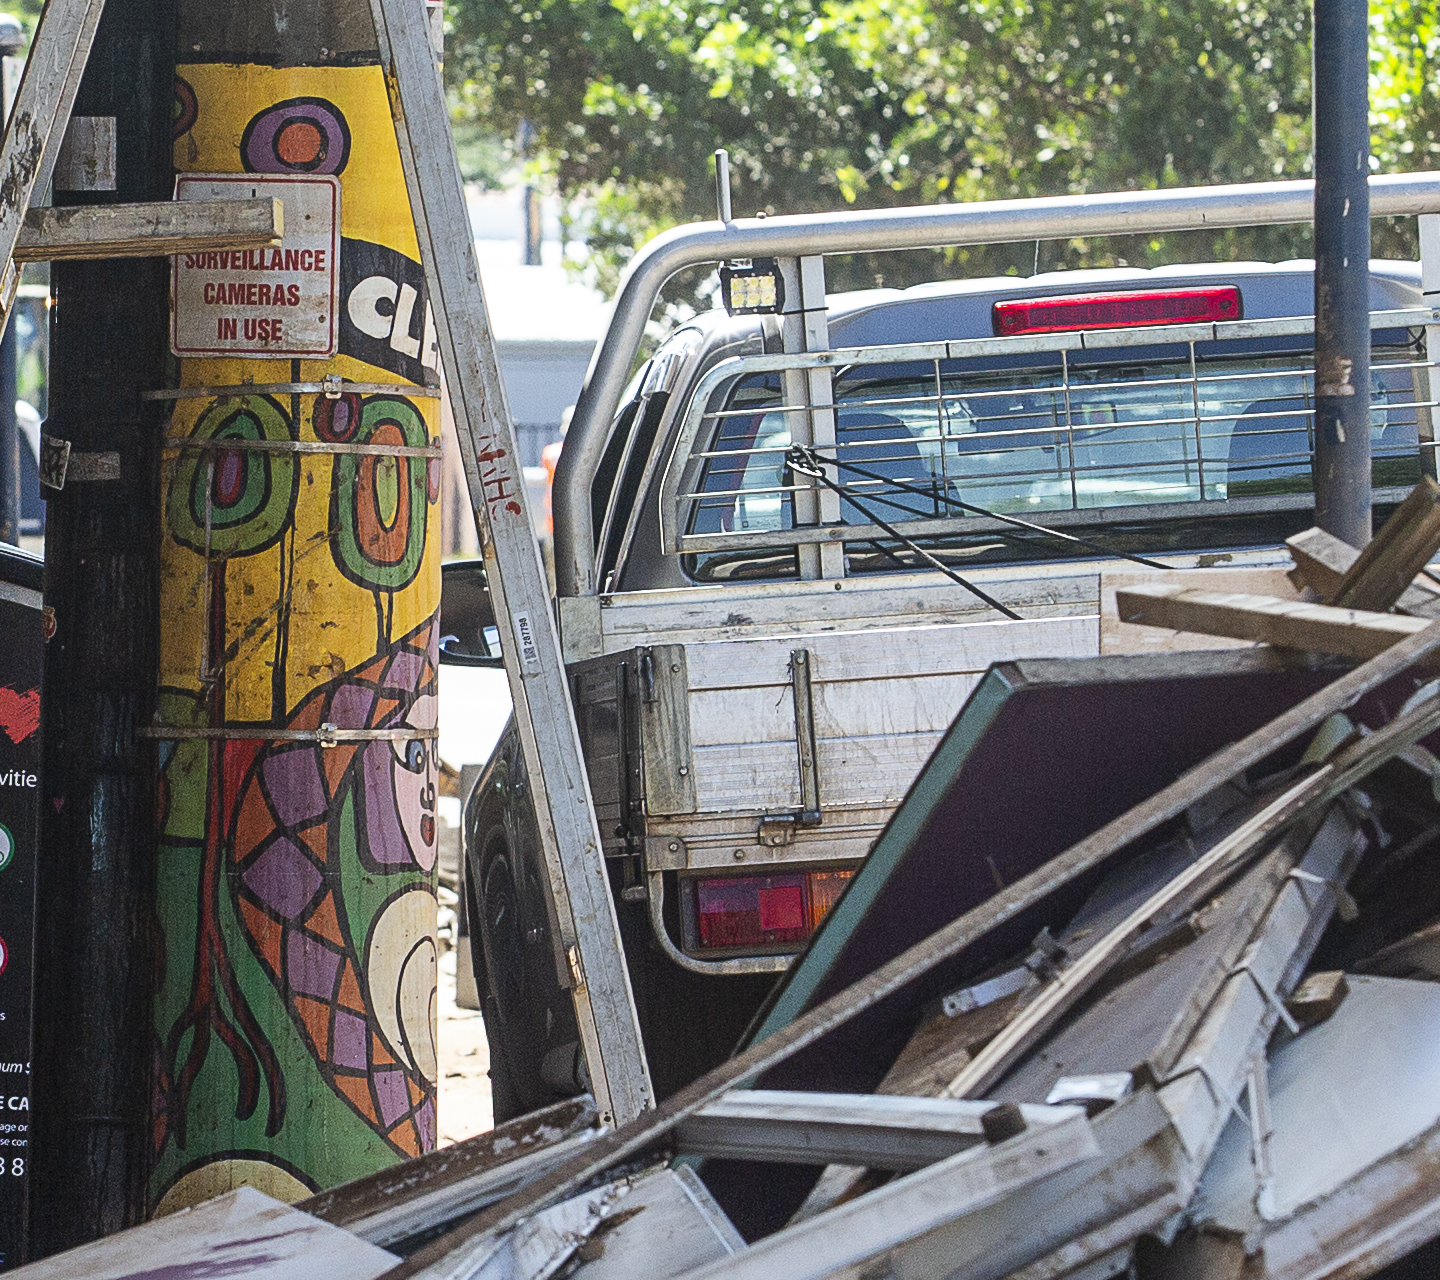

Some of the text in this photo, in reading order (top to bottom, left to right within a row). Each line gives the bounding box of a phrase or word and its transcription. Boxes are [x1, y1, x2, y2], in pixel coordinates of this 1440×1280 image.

[184, 248, 326, 272] SURVEILLANCE
[203, 282, 300, 307] CAMERAS
[217, 317, 283, 342] IN USE
[7, 1095, 30, 1111] CA
[11, 1138, 29, 1148] con
[11, 1157, 26, 1177] 8
